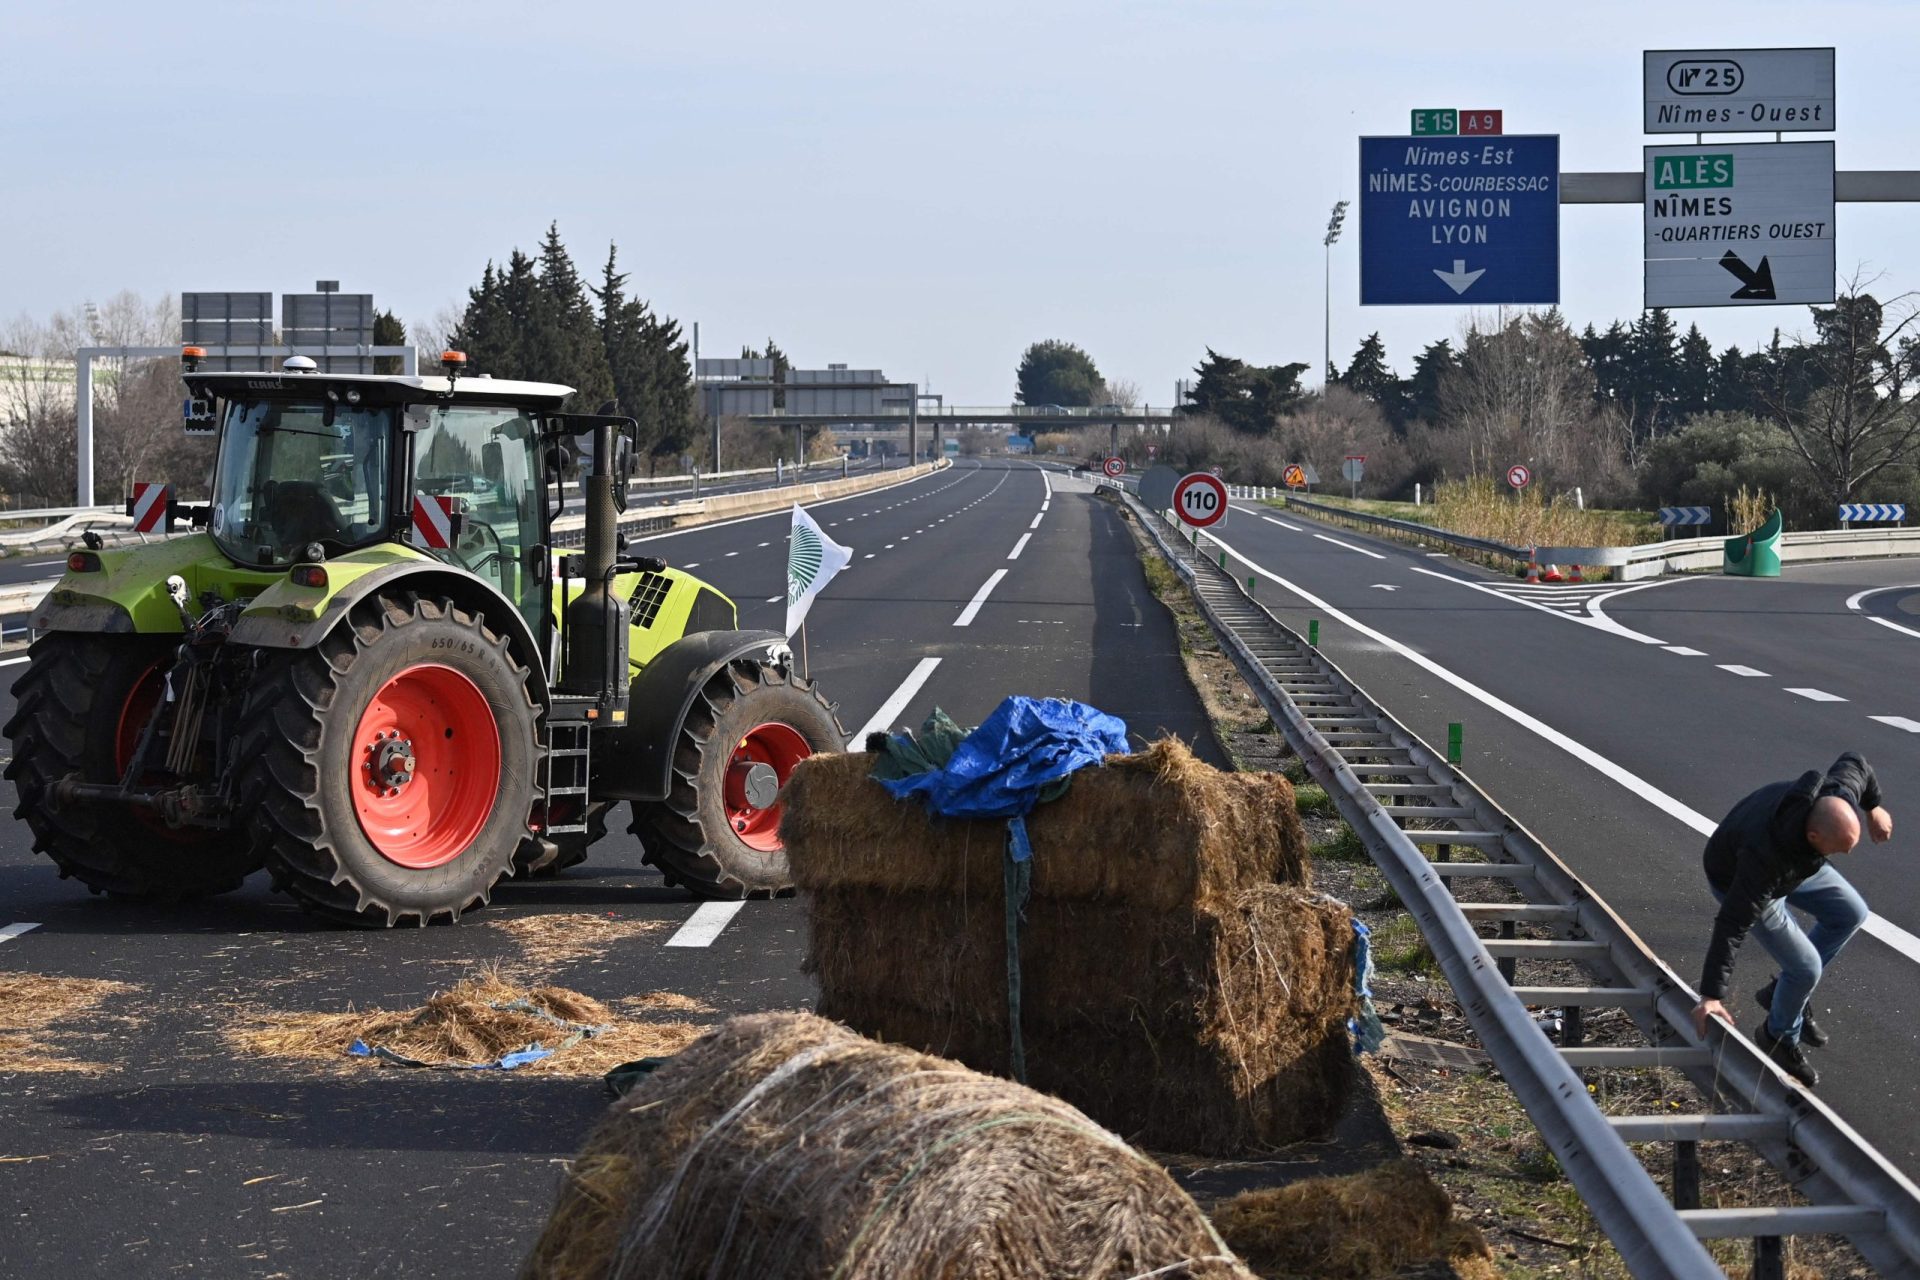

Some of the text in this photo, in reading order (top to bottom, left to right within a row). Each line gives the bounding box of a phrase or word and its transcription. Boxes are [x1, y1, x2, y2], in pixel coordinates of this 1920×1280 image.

[1705, 68, 1736, 87] 25
[1658, 103, 1822, 124] Nîmes-Ouest
[1405, 146, 1514, 166] Nîmes-Est
[1369, 168, 1549, 193] NÎMES-COURBESSAC
[1659, 156, 1729, 185] ALÈS
[1408, 198, 1511, 218] AVIGNON
[1654, 194, 1733, 217] NÎMES
[1431, 224, 1487, 244] LYON
[1768, 223, 1826, 239] OUEST
[1110, 463, 1120, 471] 90
[1184, 490, 1217, 511] 110
[431, 638, 474, 654] 650/65
